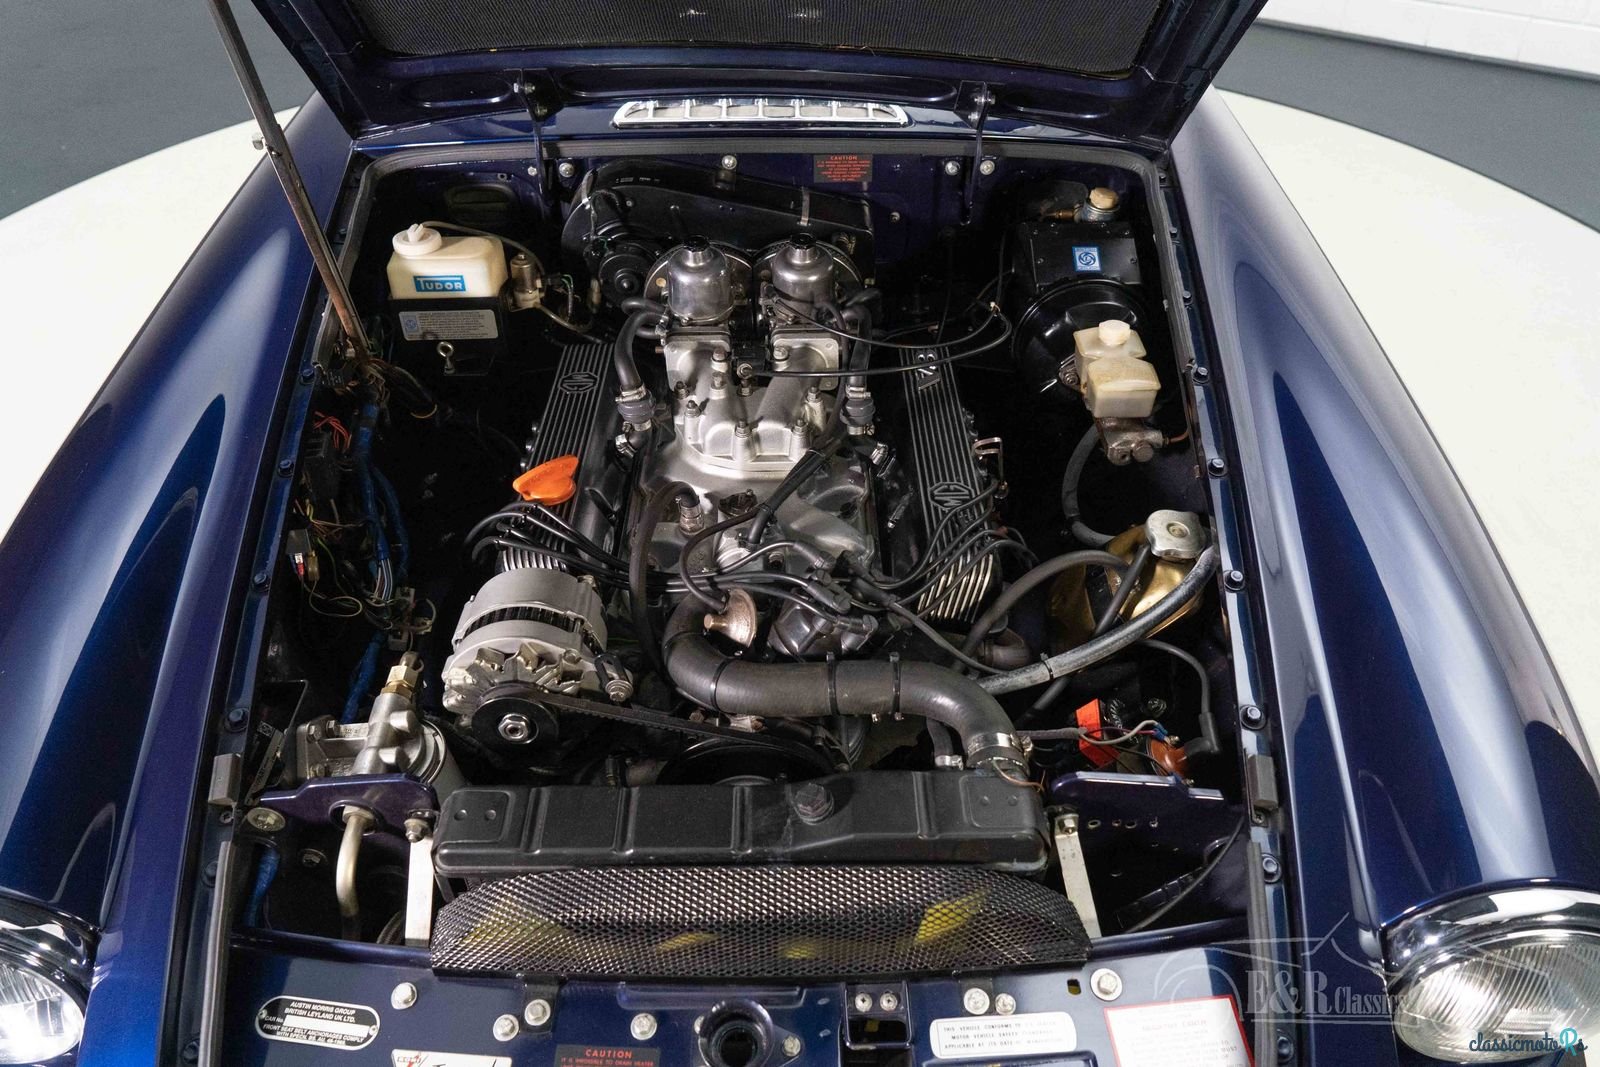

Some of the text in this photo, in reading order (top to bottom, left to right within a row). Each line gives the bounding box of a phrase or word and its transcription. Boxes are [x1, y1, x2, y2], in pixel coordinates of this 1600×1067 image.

[416, 276, 463, 290] TUDOR
[290, 1001, 356, 1015] AUSTIN MORRIS GROUP
[284, 1008, 307, 1016] BRITISH
[307, 1011, 334, 1020] LEYLAND
[343, 1015, 356, 1023] LTD.
[263, 1023, 280, 1031] FRONT
[307, 1029, 343, 1040] ANCHORAGES
[342, 1034, 365, 1043] COMPLY
[585, 1049, 633, 1059] CAUTION
